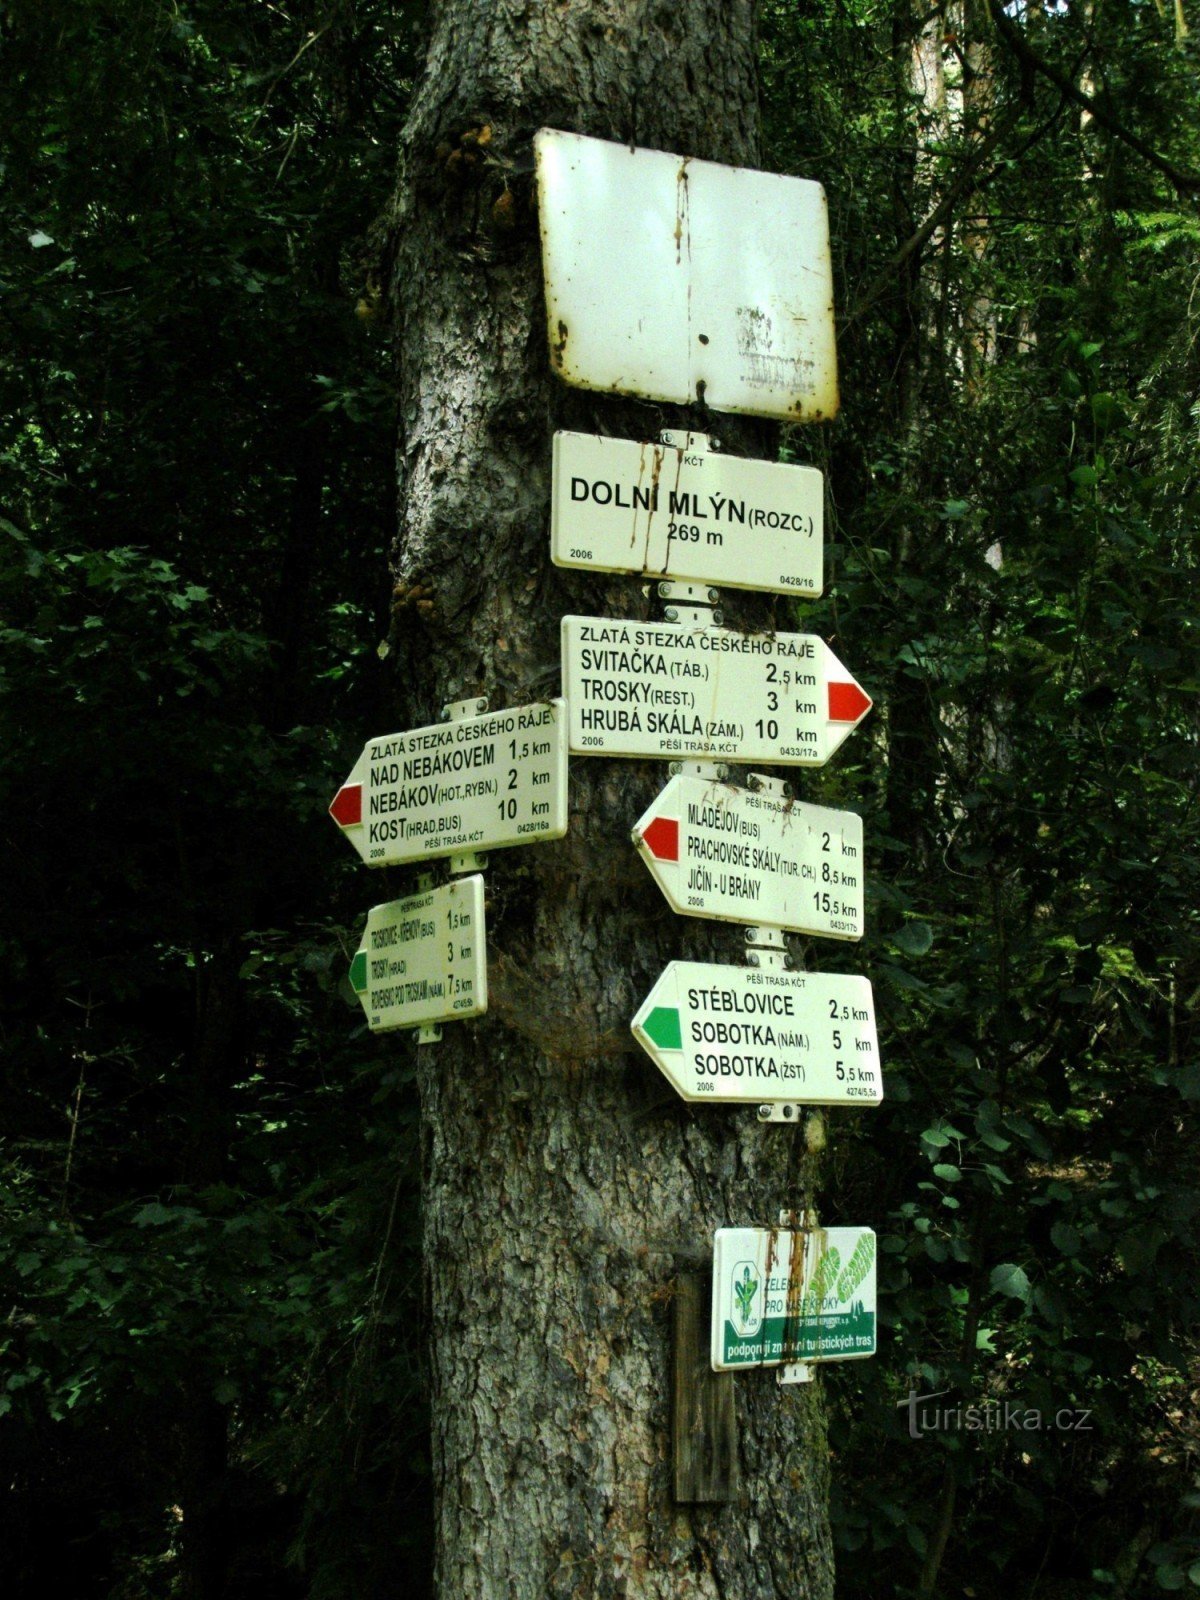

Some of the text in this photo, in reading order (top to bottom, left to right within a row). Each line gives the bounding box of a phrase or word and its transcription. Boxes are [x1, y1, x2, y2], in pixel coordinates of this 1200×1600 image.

[684, 456, 703, 466] KČT
[669, 491, 745, 523] MLÝN
[749, 509, 814, 537] (ROZC.)
[667, 523, 723, 545] 269 m
[570, 549, 592, 560] 2006
[780, 575, 814, 587] 0428/16
[580, 627, 815, 658] ZLATÁ STEZKA ČESKÉHO RÁJE
[581, 649, 666, 675] SVITAČKA
[766, 664, 790, 684] 2,5
[795, 672, 816, 685] km
[767, 692, 778, 711] 3
[795, 700, 817, 713] km
[371, 711, 550, 760] ZLATÁ STEZKA ČESKÉHO RÁJE
[581, 709, 641, 732] HRUBÁ
[647, 709, 703, 735] SKÁLA
[755, 720, 778, 740] 10
[797, 728, 817, 742] km
[582, 736, 604, 746] 2006
[660, 739, 737, 753] PĚŠÍ TRASA KČT
[780, 747, 818, 758] 0433/17a
[370, 740, 551, 787] NAD NEBÁKOVEM 1,5 km
[508, 769, 517, 789] 2
[532, 772, 550, 785] km
[498, 799, 517, 821] 10
[532, 801, 550, 815] km
[517, 822, 549, 834] 0428/16a
[425, 831, 484, 849] PĚŠÍ TRASA KČT
[822, 832, 830, 851] 2
[842, 842, 856, 858] km
[370, 848, 385, 858] 2006
[688, 836, 749, 867] PRACHOVSKÉ
[822, 863, 839, 884] 8,5
[842, 873, 856, 887] km
[688, 866, 712, 893] JIČÍN
[720, 878, 726, 893] U
[729, 877, 761, 901] BRÁNY
[813, 892, 839, 915] 15,5
[842, 902, 857, 918] km
[688, 896, 704, 907] 2006
[447, 910, 459, 931] 1,5
[460, 914, 470, 926] km
[448, 942, 453, 962] 3
[461, 947, 471, 959] km
[448, 974, 460, 995] 7,5
[462, 979, 472, 992] km
[766, 977, 790, 986] TRASA
[792, 978, 805, 988] KČT
[829, 999, 849, 1020] 2,5
[852, 1008, 868, 1021] km
[692, 1021, 776, 1047] SOBOTKA
[833, 1030, 841, 1049] 5
[856, 1038, 871, 1051] km
[695, 1054, 779, 1078] SOBOTKA
[836, 1061, 855, 1081] 5,5
[858, 1068, 874, 1082] km
[697, 1082, 714, 1091] 2006
[847, 1087, 877, 1097] 4274/5,5a
[765, 1299, 783, 1313] PRO
[856, 1336, 871, 1346] tras
